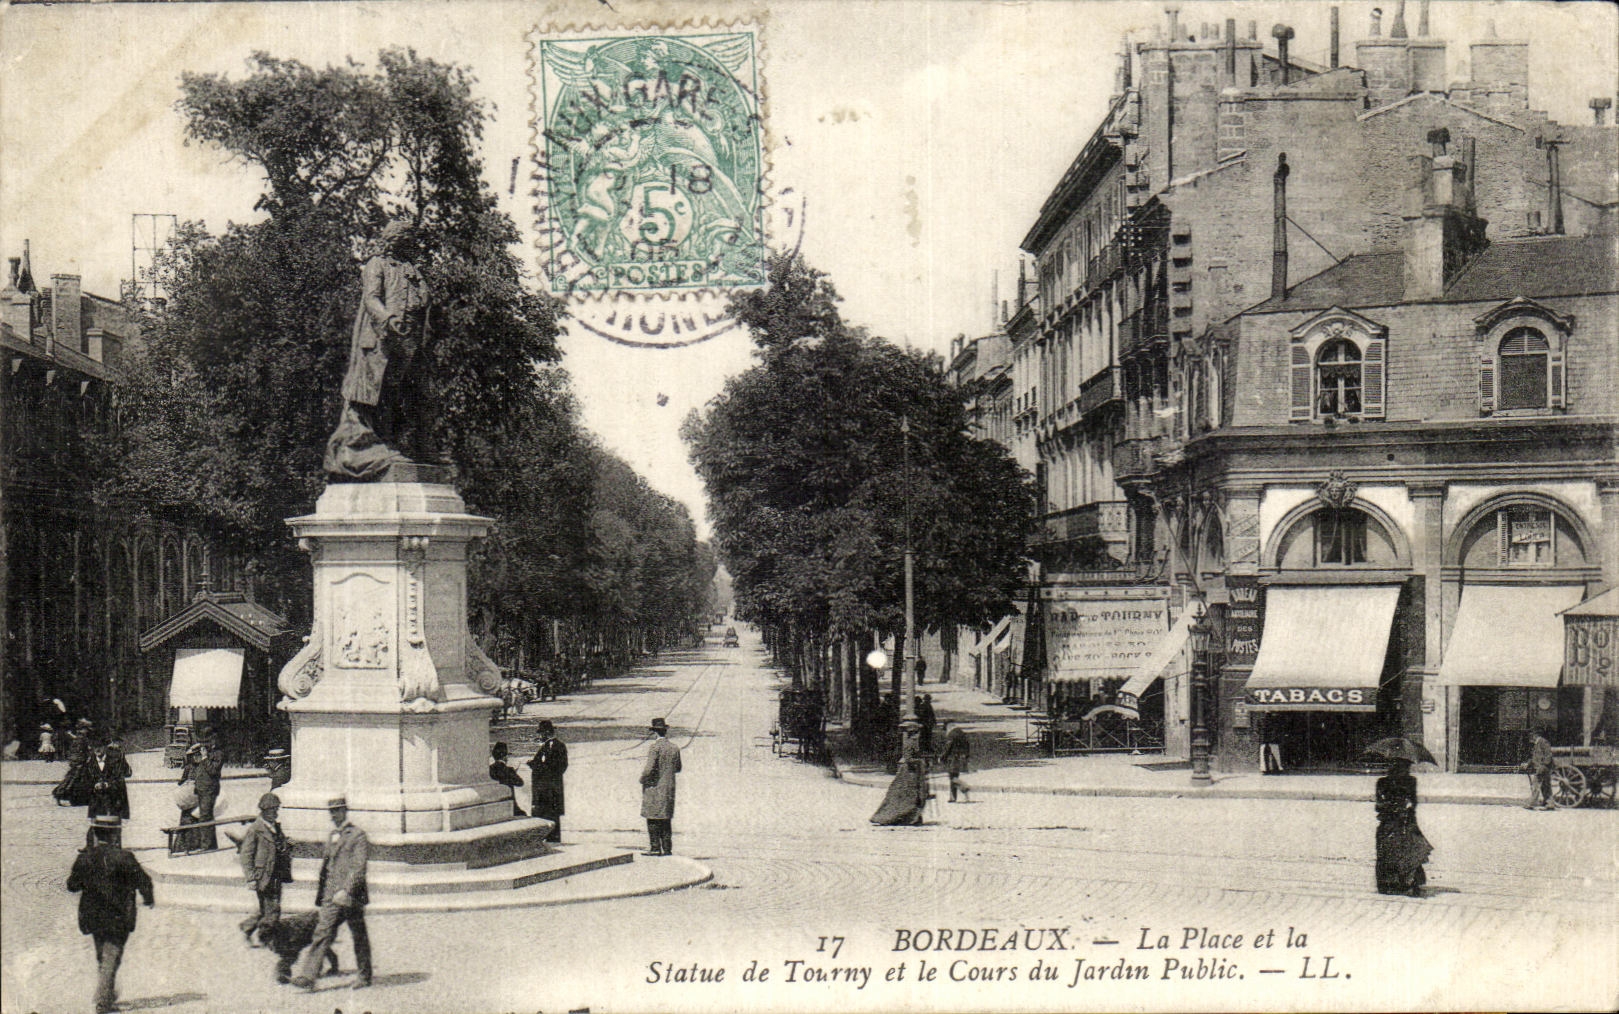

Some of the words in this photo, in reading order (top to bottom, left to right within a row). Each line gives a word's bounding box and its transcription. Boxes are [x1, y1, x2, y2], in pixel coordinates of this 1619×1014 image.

[611, 263, 707, 287] POSTES
[1236, 625, 1253, 633] DES
[1231, 638, 1259, 654] POSTES
[1253, 689, 1364, 703] TABACS
